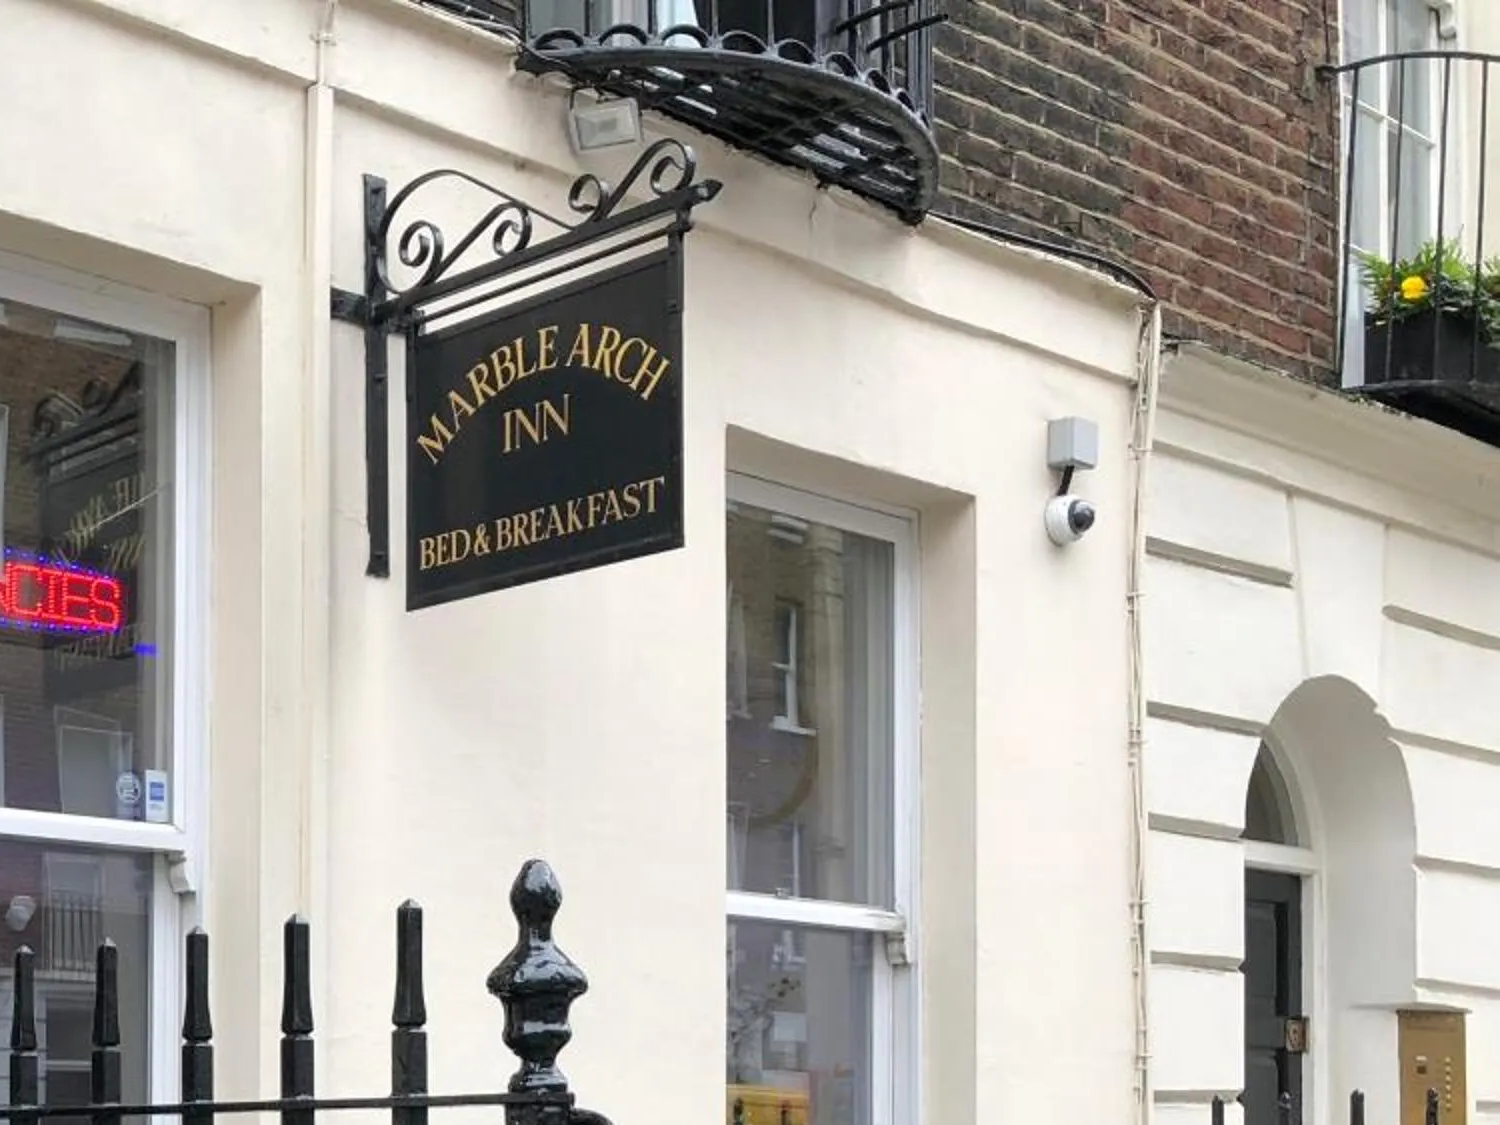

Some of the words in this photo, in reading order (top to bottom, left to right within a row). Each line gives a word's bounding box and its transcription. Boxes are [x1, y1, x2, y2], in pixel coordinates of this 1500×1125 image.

[417, 325, 559, 465] MARBLE
[564, 322, 671, 401] ARCH
[502, 393, 573, 454] INN
